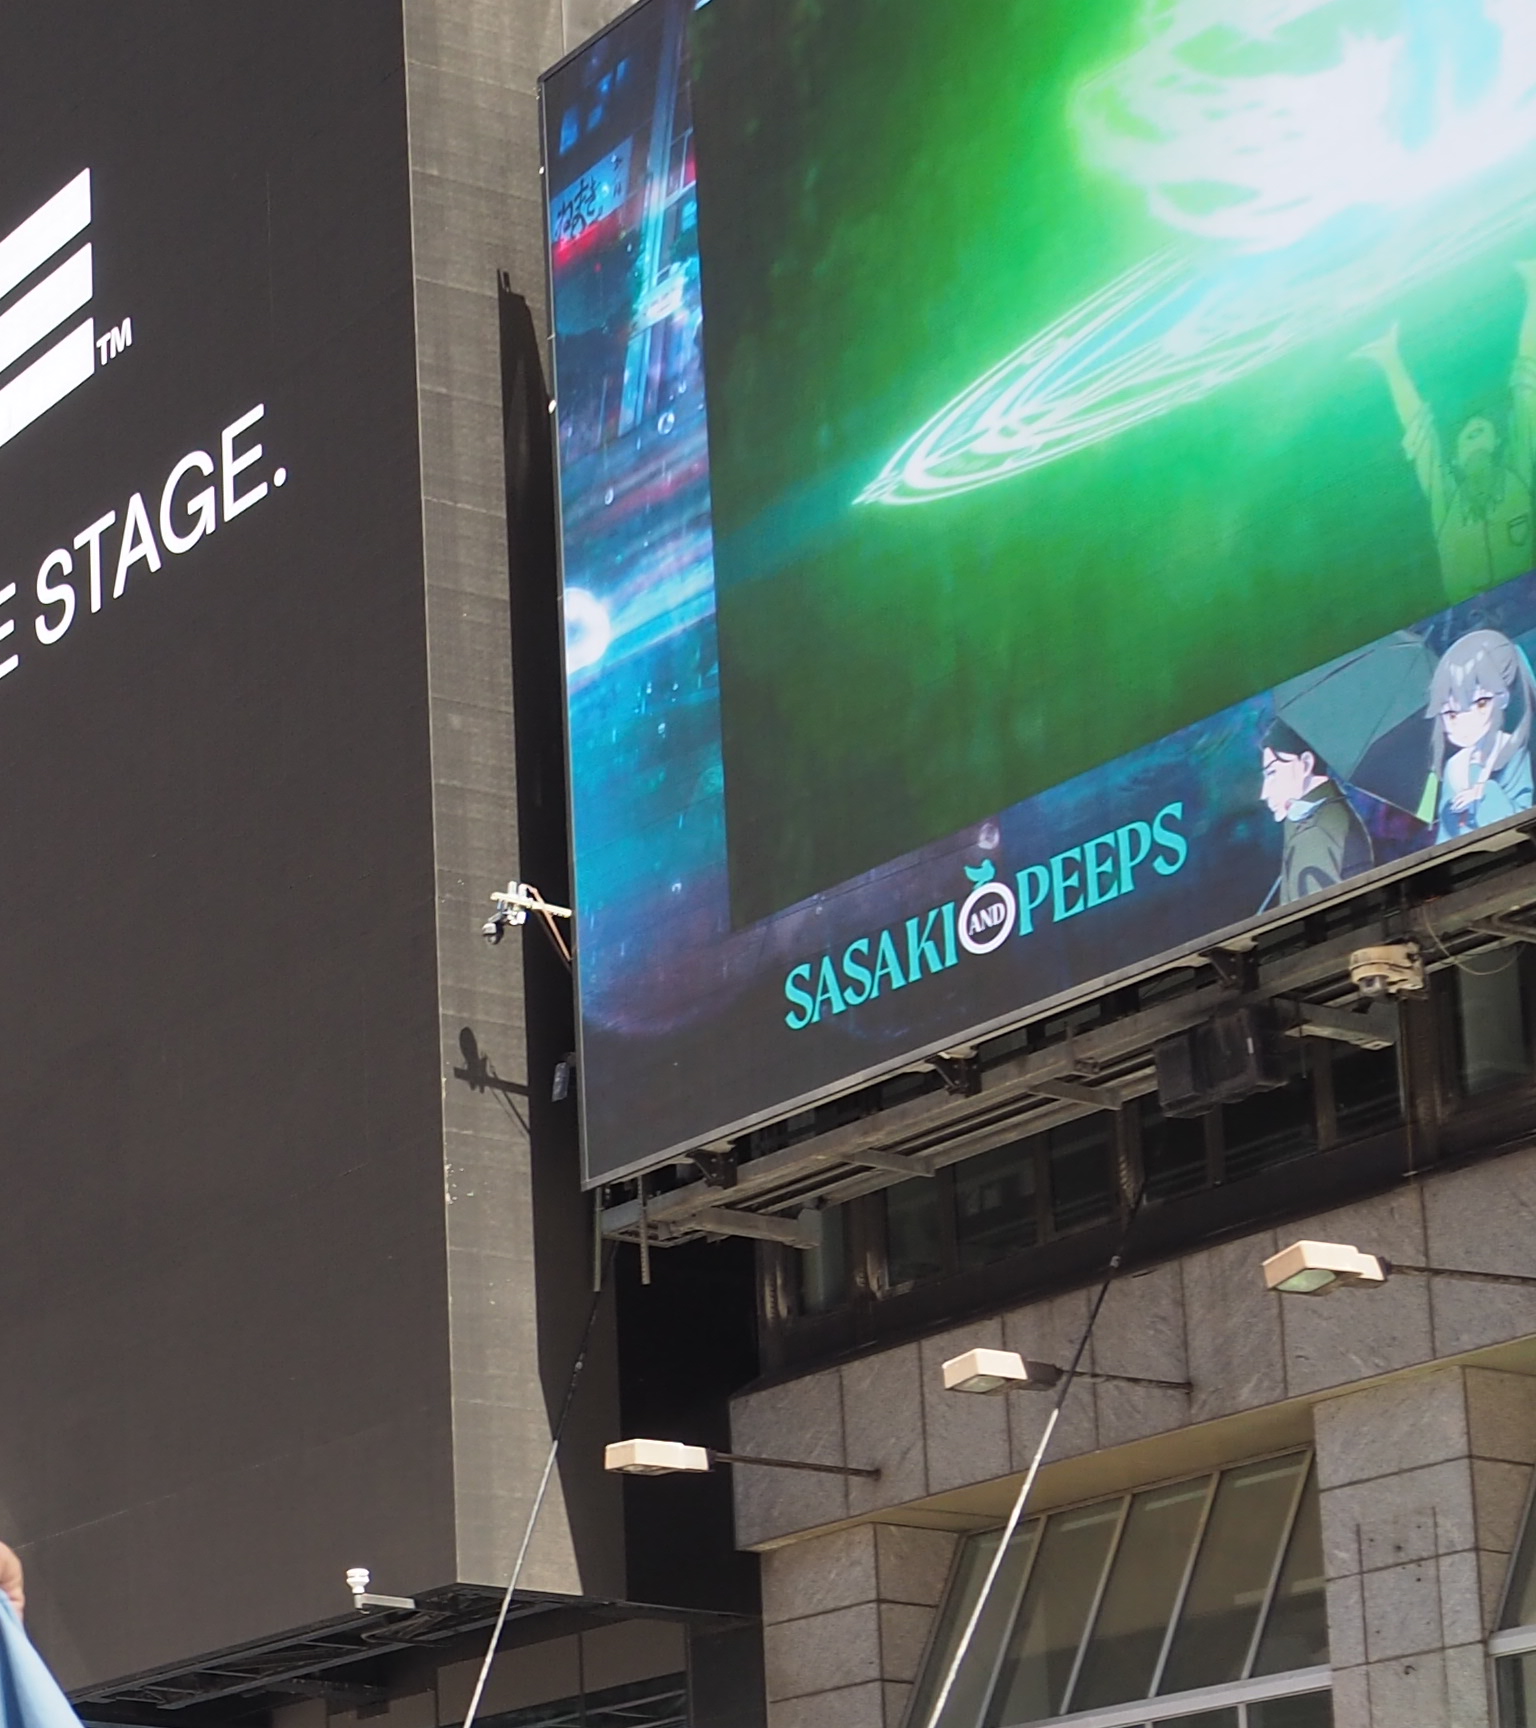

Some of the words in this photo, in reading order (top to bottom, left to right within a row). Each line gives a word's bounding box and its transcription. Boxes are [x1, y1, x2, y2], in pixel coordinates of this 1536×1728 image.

[35, 403, 288, 646] STAGE.
[784, 901, 958, 1030] SASAKI
[968, 902, 1007, 936] AND
[1015, 802, 1189, 937] PEEPS
